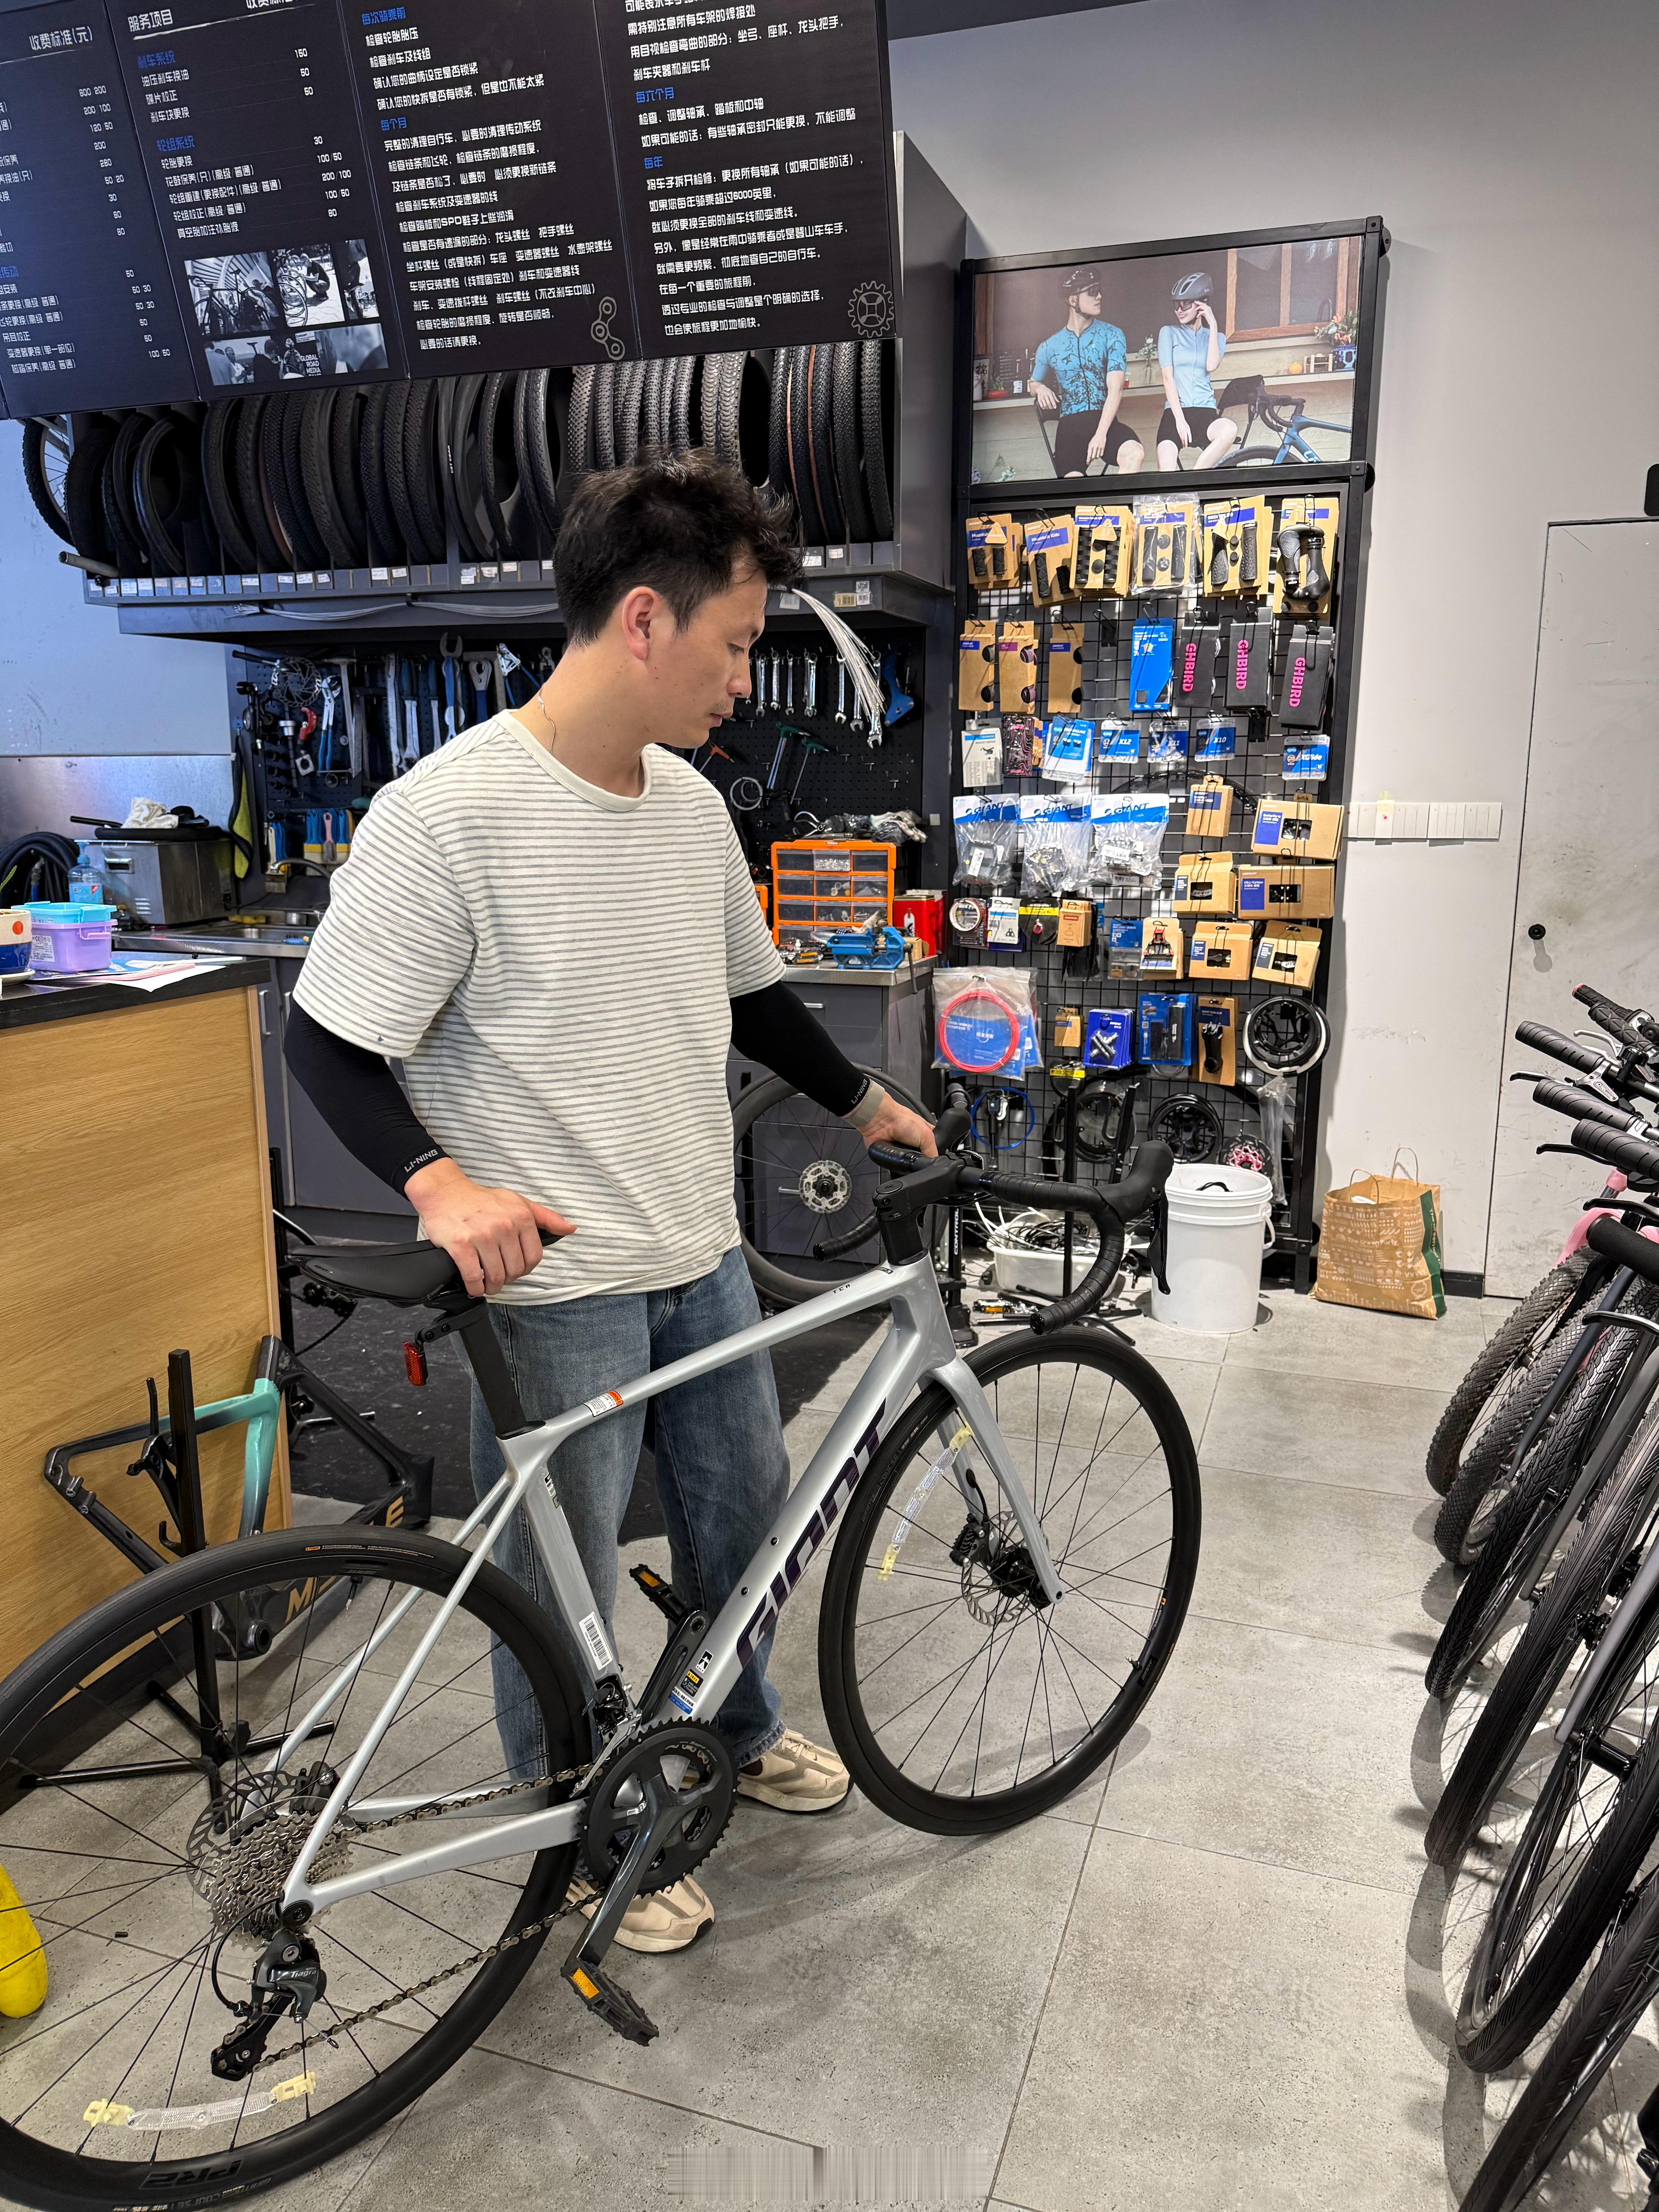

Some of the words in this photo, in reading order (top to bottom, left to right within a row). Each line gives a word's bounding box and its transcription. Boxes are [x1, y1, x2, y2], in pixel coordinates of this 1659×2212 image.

[127, 9, 173, 32] 服务项目
[362, 7, 406, 25] 每次骑乘前
[628, 4, 756, 36] 需特别注意所有车架的焊接处
[29, 26, 93, 50] 收费标准(元)
[366, 27, 419, 47] 检查轮胎胎压
[137, 50, 176, 69] 刹车系统
[141, 69, 189, 87] 油压刹车换油
[295, 48, 308, 58] 150
[369, 48, 431, 68] 检查刹车及线组
[373, 62, 478, 89] 确认您的曲柄设定是否锁紧
[634, 58, 710, 81] 刹车夹器和刹车杆
[146, 89, 178, 105] 碟片校正
[300, 67, 310, 77] 50
[635, 87, 674, 103] 每六个月
[150, 107, 190, 123] 刹车块更换
[304, 86, 313, 96] 50
[381, 117, 407, 131] 每个月
[94, 141, 106, 150] 200
[156, 135, 195, 152] 轮组系统
[161, 155, 193, 170] 轮胎更换
[314, 136, 323, 144] 30
[644, 156, 663, 169] 每年
[108, 194, 117, 202] 30
[395, 191, 498, 213] 检查刹车系统及变速器的线
[177, 221, 239, 239] 真空胎加注补胎液
[328, 209, 337, 217] 80
[538, 224, 574, 237] 把手螺丝
[515, 246, 560, 261] 变速器螺丝
[126, 270, 134, 278] 50
[139, 318, 148, 326] 50
[1042, 803, 1073, 815] GIANT
[1113, 803, 1149, 814] GIANT
[851, 1079, 867, 1104] LI-NING
[404, 1149, 438, 1173] LI-NING
